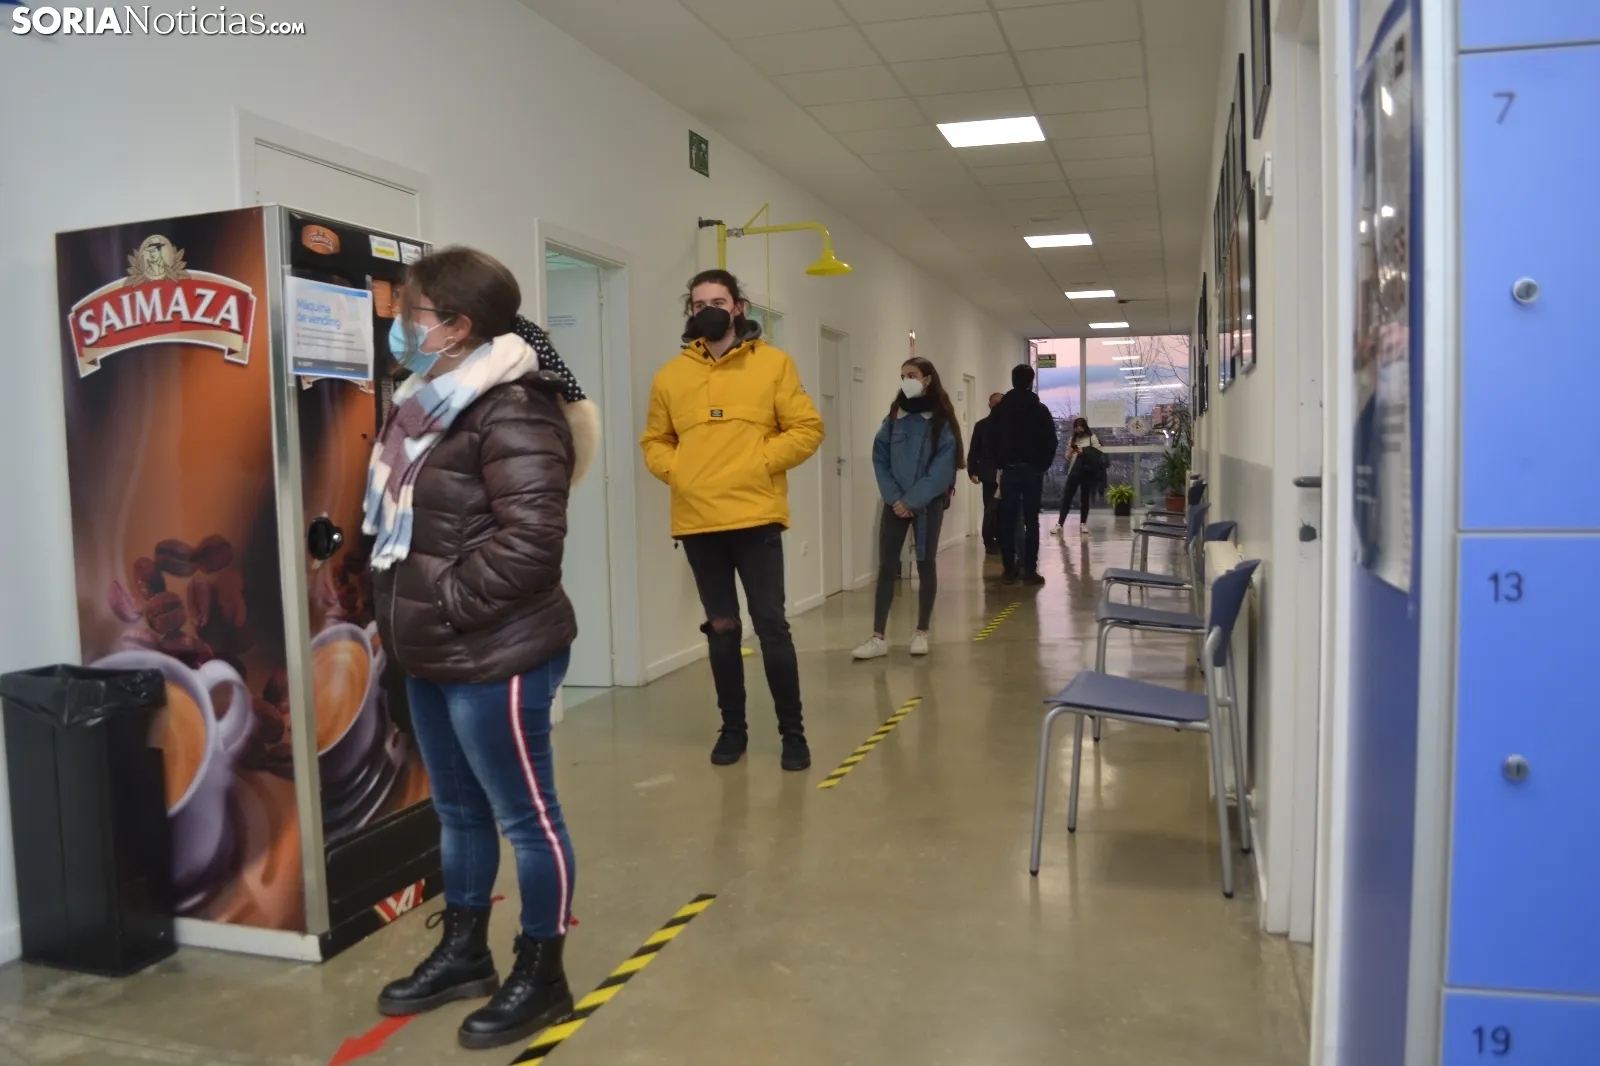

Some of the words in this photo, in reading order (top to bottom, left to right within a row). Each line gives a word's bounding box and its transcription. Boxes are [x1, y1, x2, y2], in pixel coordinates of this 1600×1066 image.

[1492, 91, 1516, 125] 7
[78, 286, 241, 346] SAIMAZA
[1487, 571, 1523, 604] 13
[1471, 1024, 1512, 1057] 19
